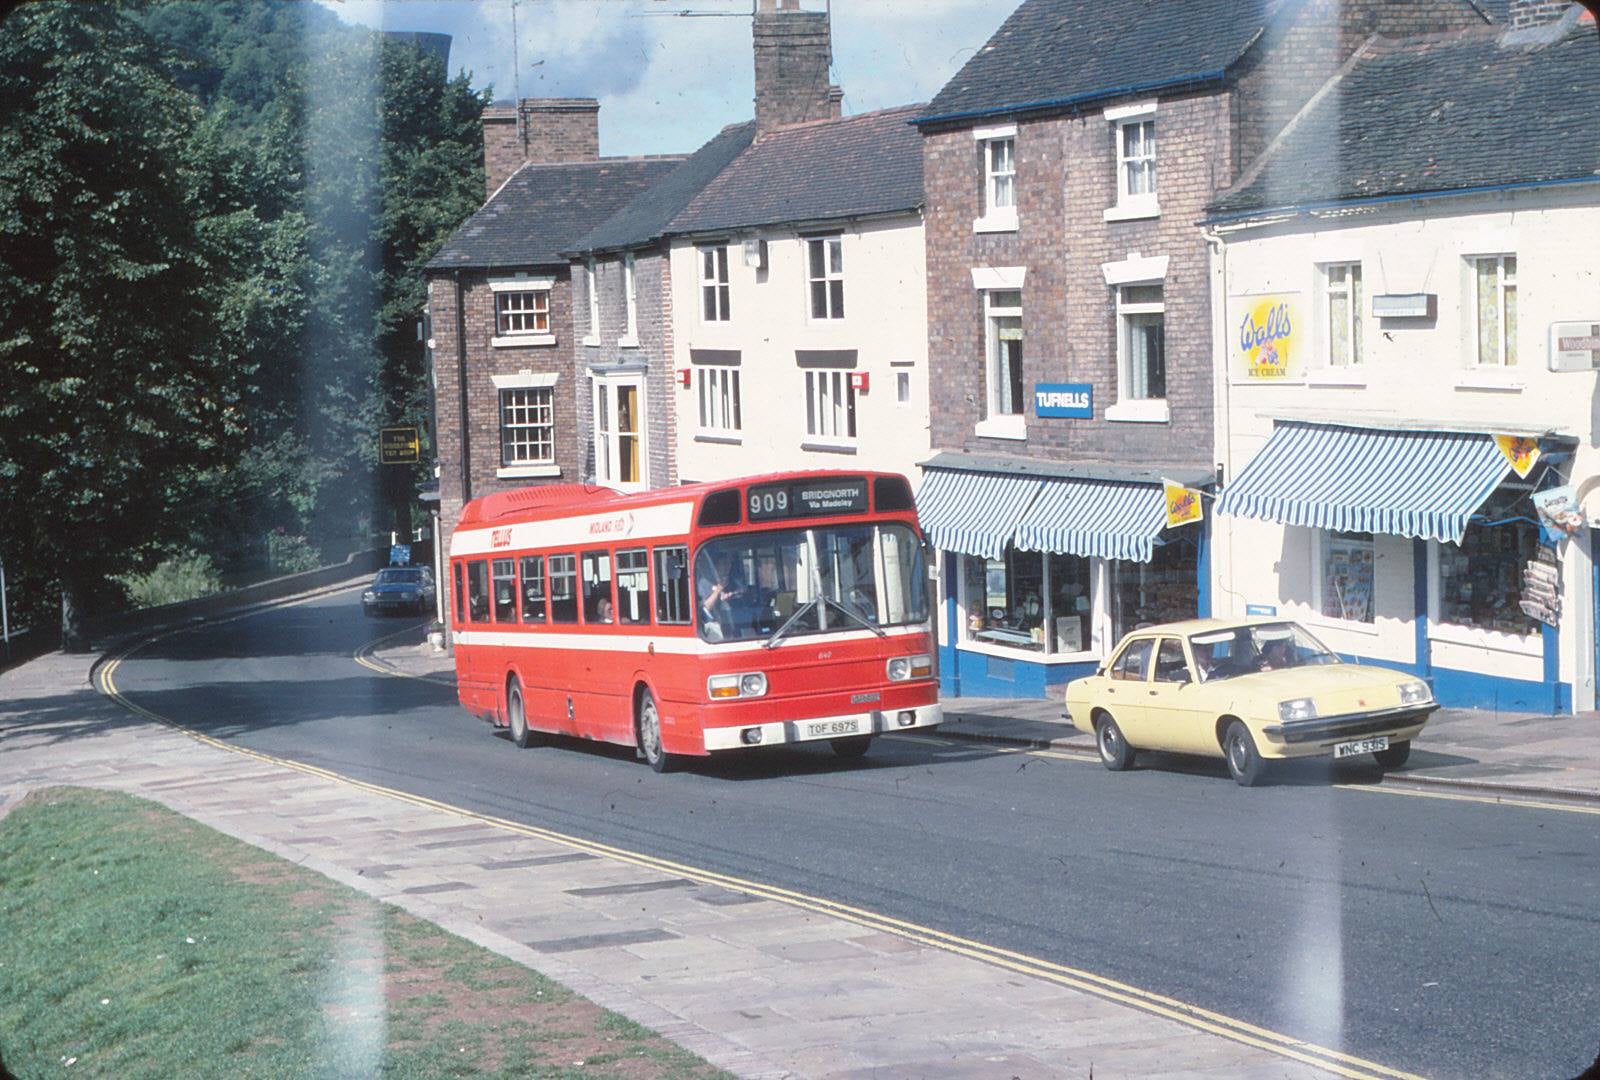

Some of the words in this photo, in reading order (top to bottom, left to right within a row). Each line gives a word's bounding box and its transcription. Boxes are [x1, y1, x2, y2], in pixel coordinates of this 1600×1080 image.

[1248, 368, 1259, 377] ICE
[1261, 367, 1286, 377] CREAM
[801, 488, 859, 500] BRIDGNORTH
[750, 490, 788, 514] 909
[822, 500, 853, 508] Madeley
[588, 521, 613, 535] MIDLAND
[809, 723, 828, 734] TOF
[831, 721, 857, 733] 697S
[1339, 743, 1359, 755] WNC
[1362, 739, 1386, 752] 931S
